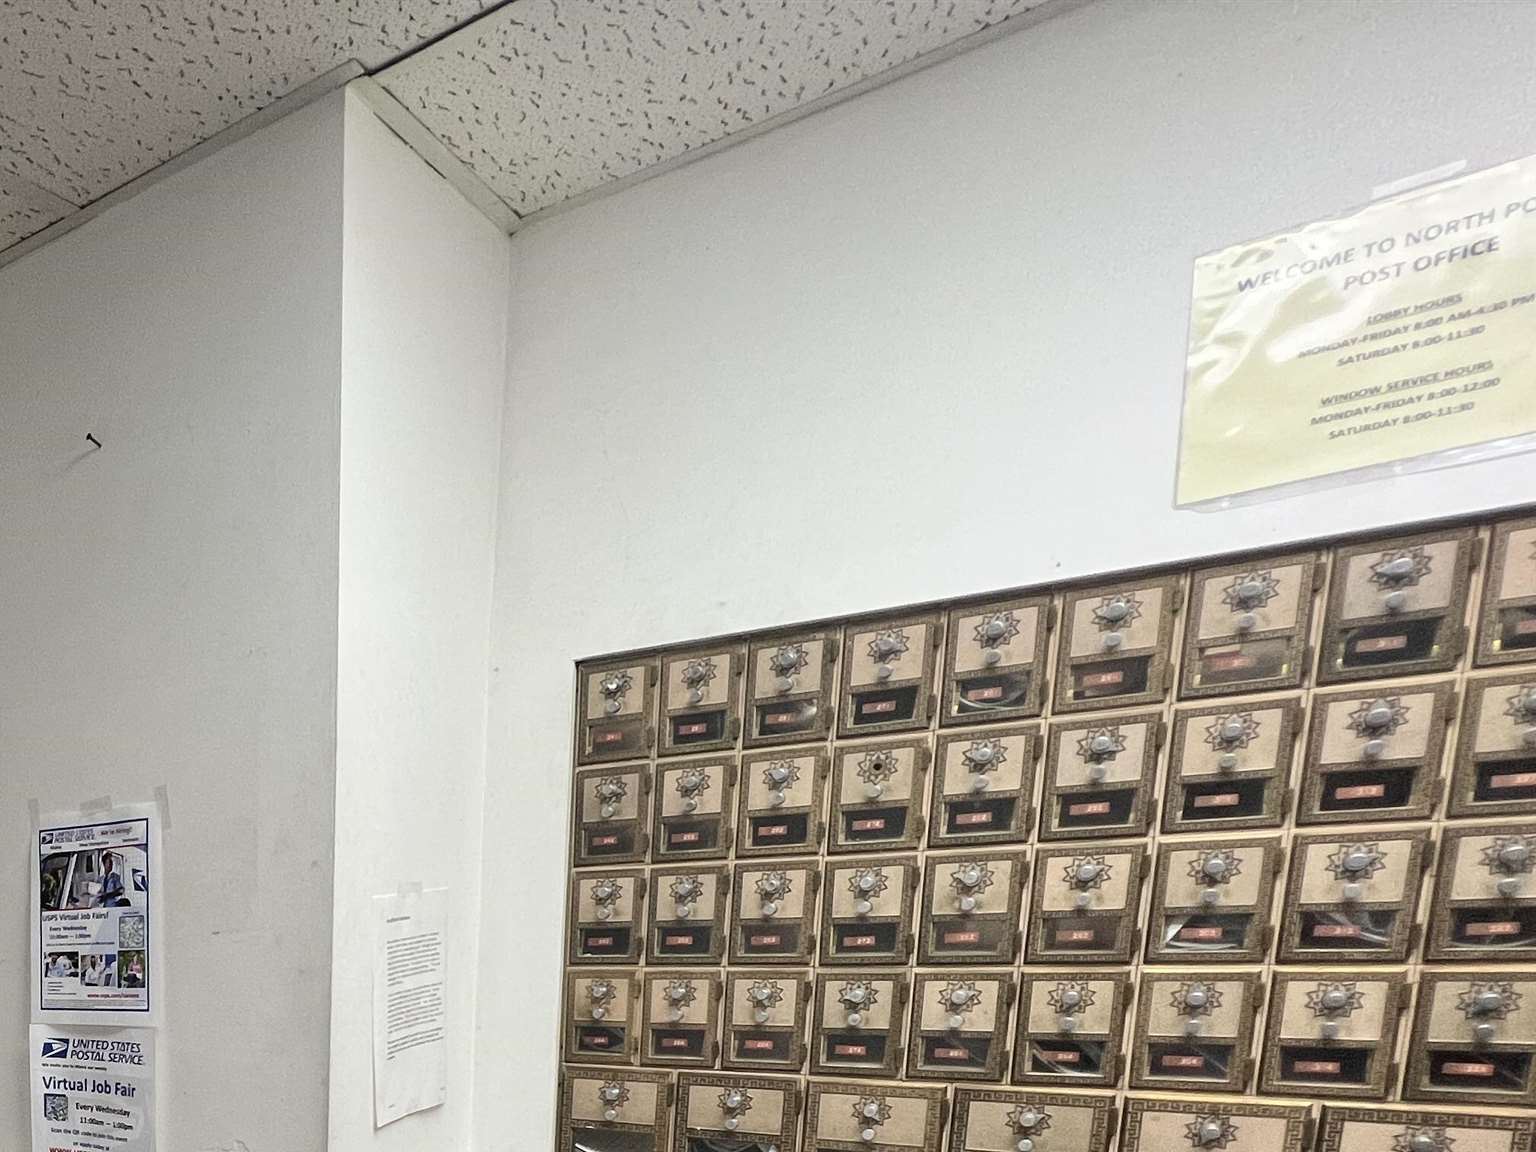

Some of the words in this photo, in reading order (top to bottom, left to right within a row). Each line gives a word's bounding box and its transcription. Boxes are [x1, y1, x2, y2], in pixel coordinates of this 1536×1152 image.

[1238, 248, 1355, 292] WELCOME
[1363, 238, 1395, 257] TO
[1405, 208, 1495, 247] NORTH
[1344, 261, 1406, 290] POST
[1414, 236, 1499, 272] OFFICE
[1366, 306, 1411, 326] LOBBY
[1414, 293, 1463, 313] HOURS
[1336, 342, 1409, 368] SATURDAY
[1320, 384, 1383, 406] WINDOW
[1386, 372, 1441, 392] SERVICE
[1444, 360, 1494, 379] HOURS
[1310, 394, 1424, 426] MONDAY-FRIDAY
[1328, 416, 1400, 441] SATURDAY
[70, 1050, 106, 1062] POSTAL
[107, 1053, 145, 1066] SERVICE
[72, 1039, 109, 1051] UNITED
[110, 1041, 141, 1053] STATES
[42, 1076, 88, 1092] Virtual
[91, 1079, 111, 1095] Job
[114, 1082, 136, 1098] Fair
[75, 1102, 94, 1113] Every
[95, 1104, 131, 1118] Wednesday
